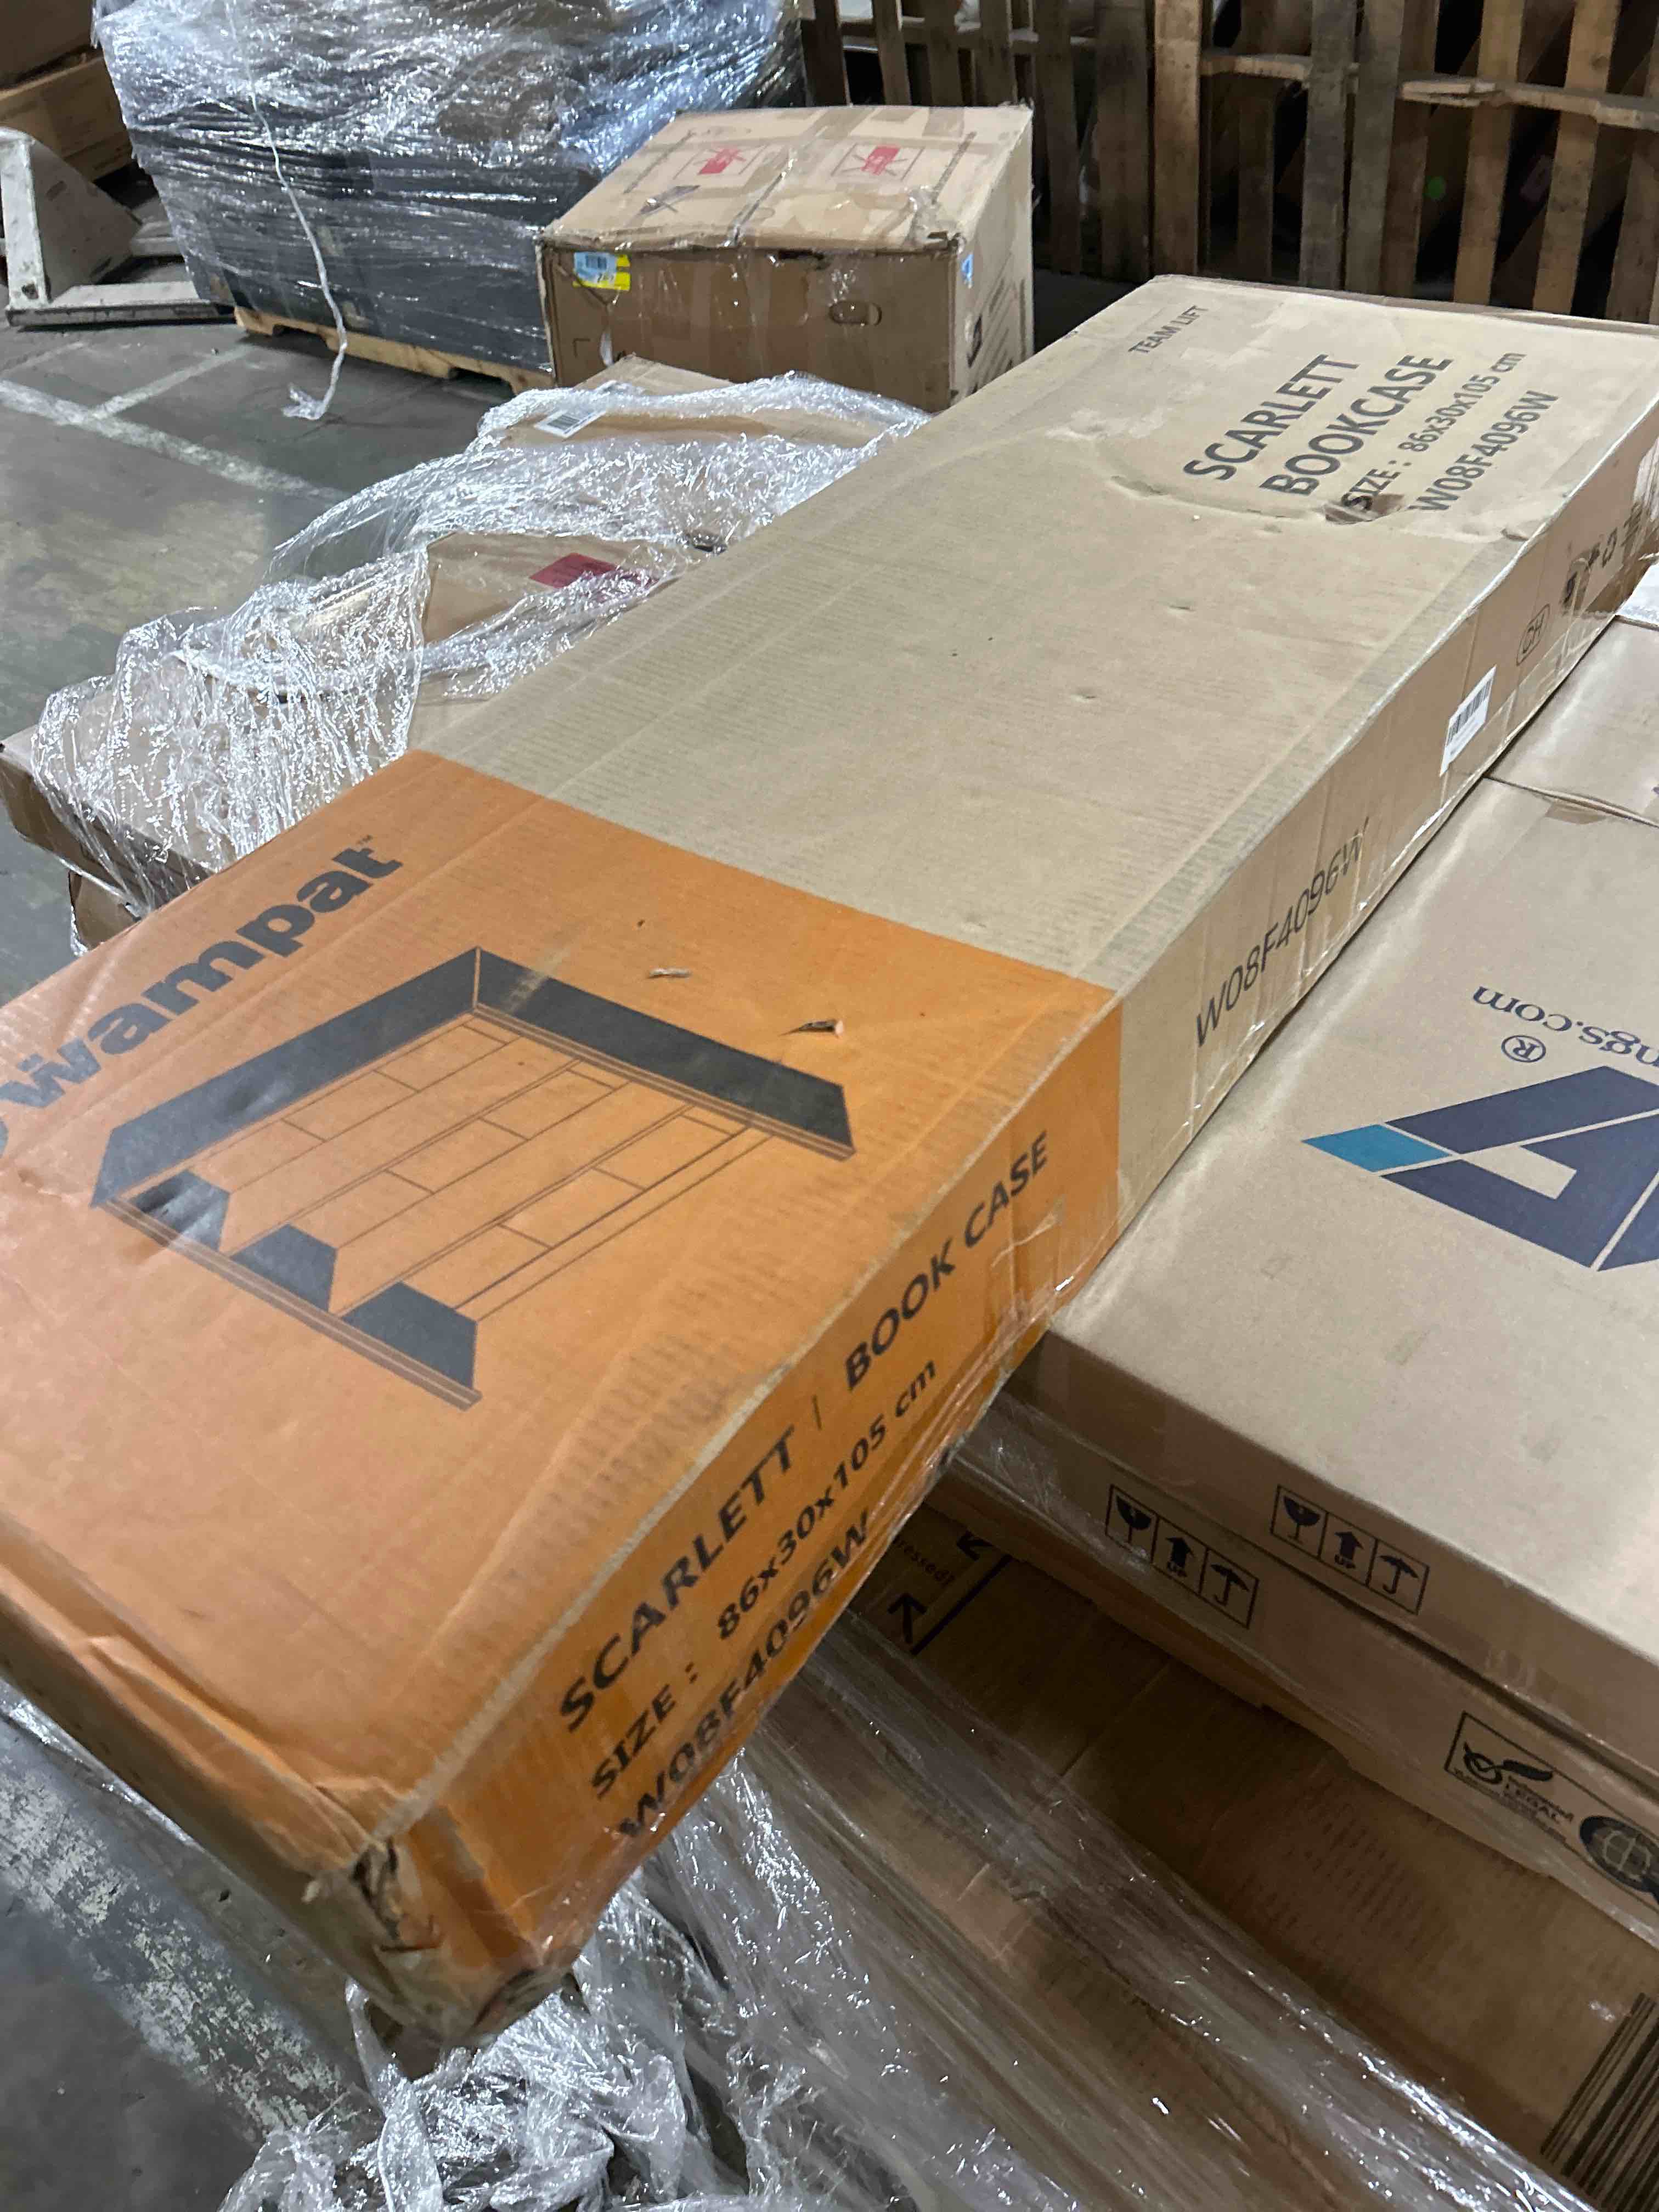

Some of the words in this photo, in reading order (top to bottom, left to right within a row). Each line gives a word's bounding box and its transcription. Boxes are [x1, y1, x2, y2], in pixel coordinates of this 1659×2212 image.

[1127, 325, 1182, 353] TEAM
[1170, 305, 1209, 325] LIFT
[1183, 354, 1360, 481] SCARLETT
[1259, 354, 1454, 496] BOOKCASE
[1341, 469, 1402, 512] SIZE
[1397, 375, 1500, 452] 86x30x105
[1490, 352, 1527, 373] cm
[1407, 390, 1559, 511] W08F4096W
[0, 848, 403, 1160] wampat
[1196, 816, 1369, 1047] W08F4096W
[560, 1424, 795, 1733] SCARLETT
[845, 1238, 956, 1392] BOOK
[964, 1130, 1047, 1249] CASE
[591, 1684, 677, 1799] SIZE
[718, 1413, 887, 1640] 86x30x105
[895, 1361, 936, 1418] cm
[619, 1506, 869, 1836] W08F4096W
